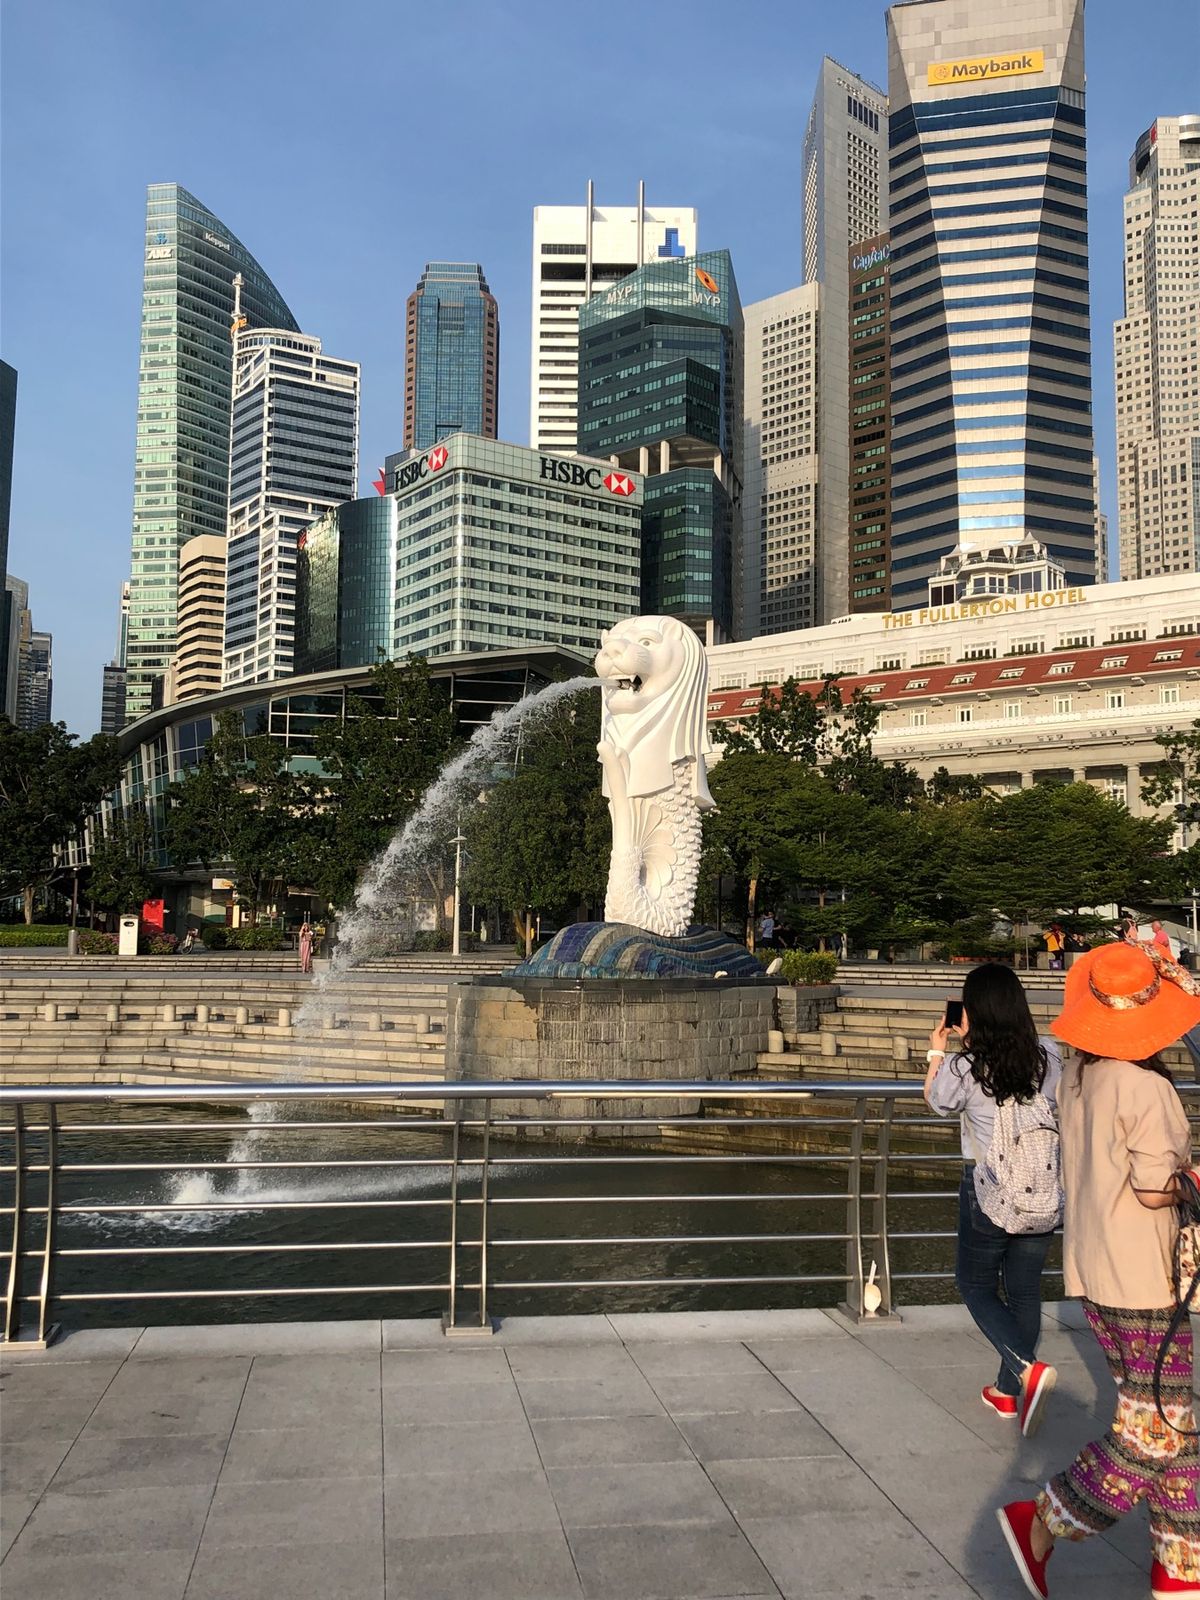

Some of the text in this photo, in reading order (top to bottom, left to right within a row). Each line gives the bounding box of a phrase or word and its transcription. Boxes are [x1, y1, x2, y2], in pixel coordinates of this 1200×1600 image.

[952, 56, 1032, 77] Maybank
[148, 248, 173, 260] ANZ
[607, 285, 633, 304] MYP
[692, 291, 721, 307] MYP
[395, 455, 429, 492] HSBC
[540, 456, 601, 490] HSBC
[882, 588, 1087, 629] THE FULLERTON HOTEL
